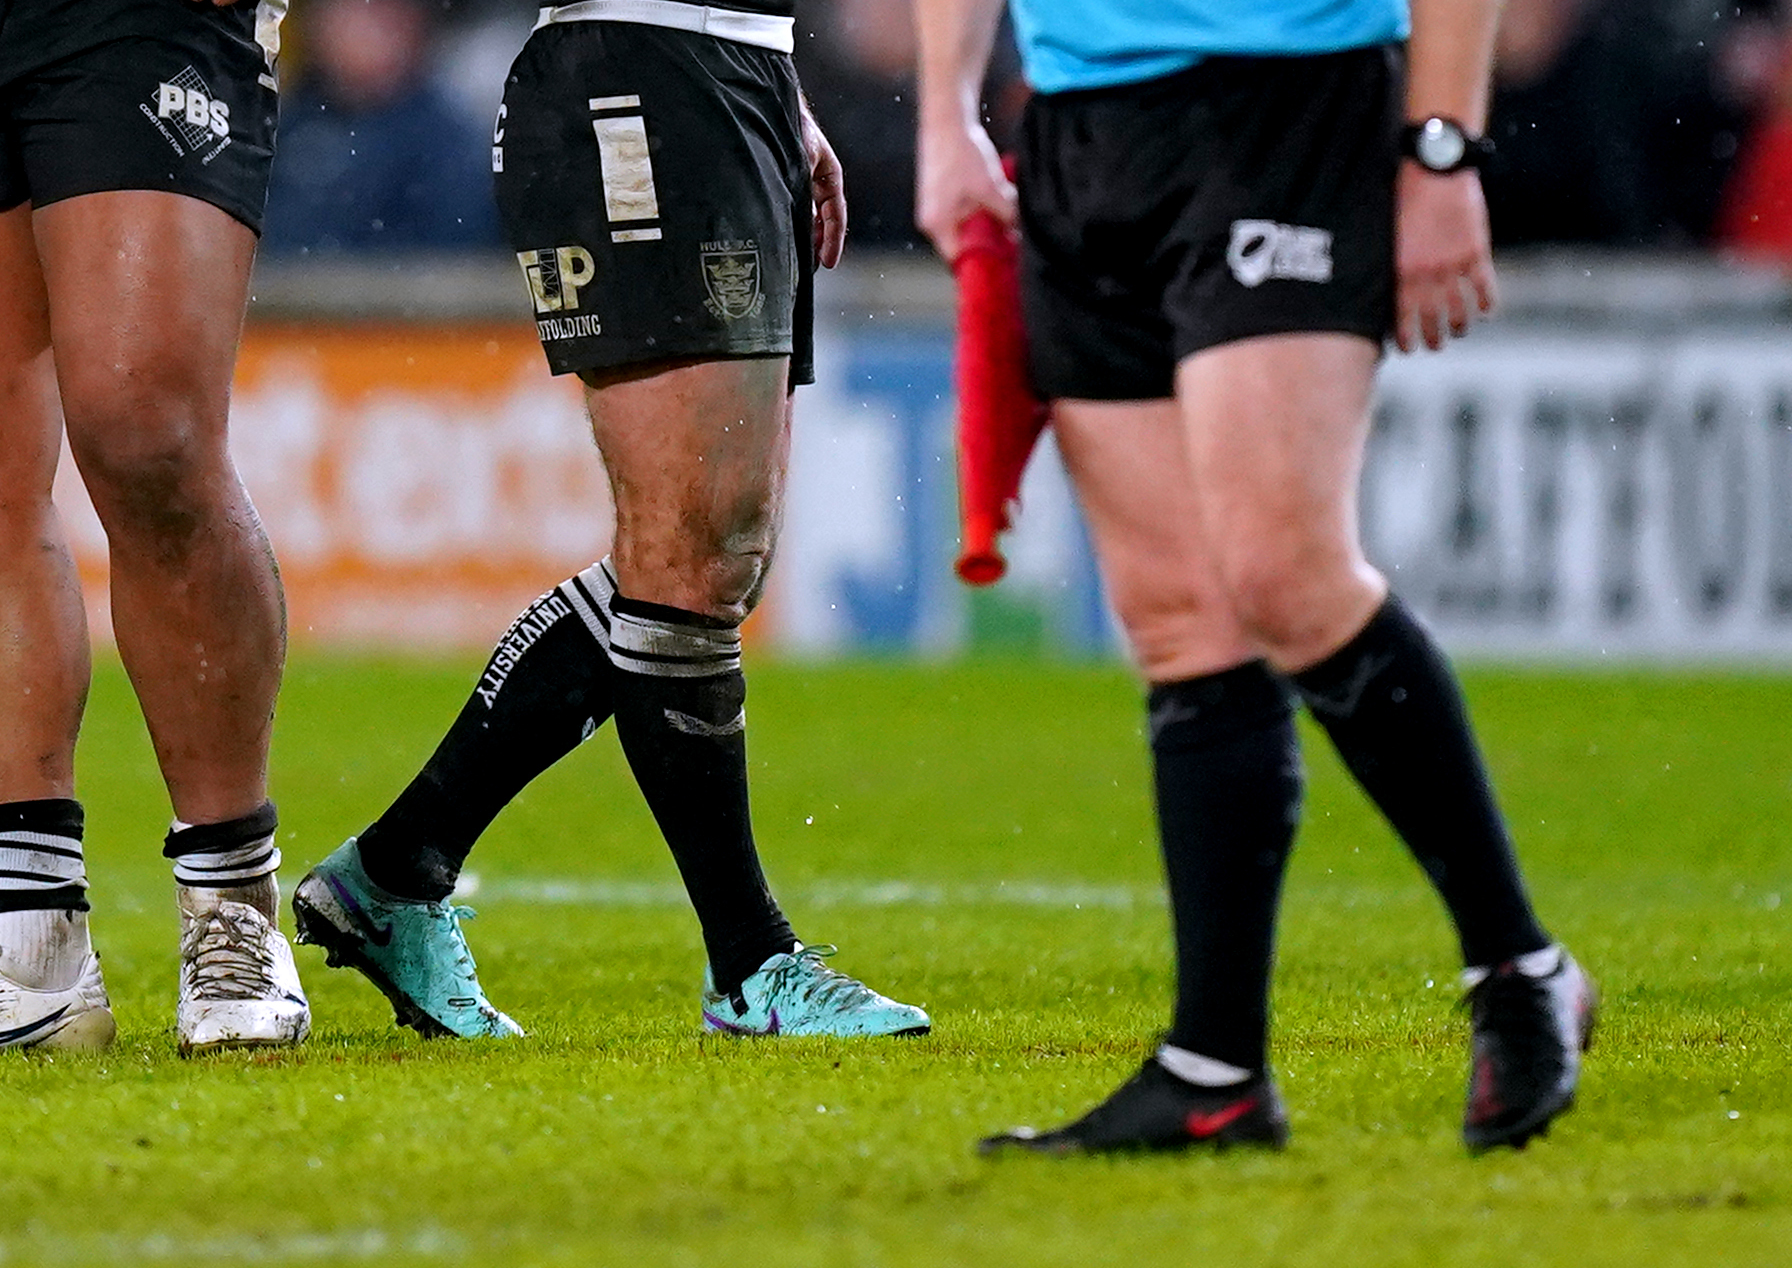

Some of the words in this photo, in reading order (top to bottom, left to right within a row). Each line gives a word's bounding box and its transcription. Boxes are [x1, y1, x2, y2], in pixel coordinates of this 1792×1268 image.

[139, 103, 185, 158] CONSTRUCTION
[158, 82, 230, 138] PBS
[476, 595, 573, 711] UNIVERSITY
